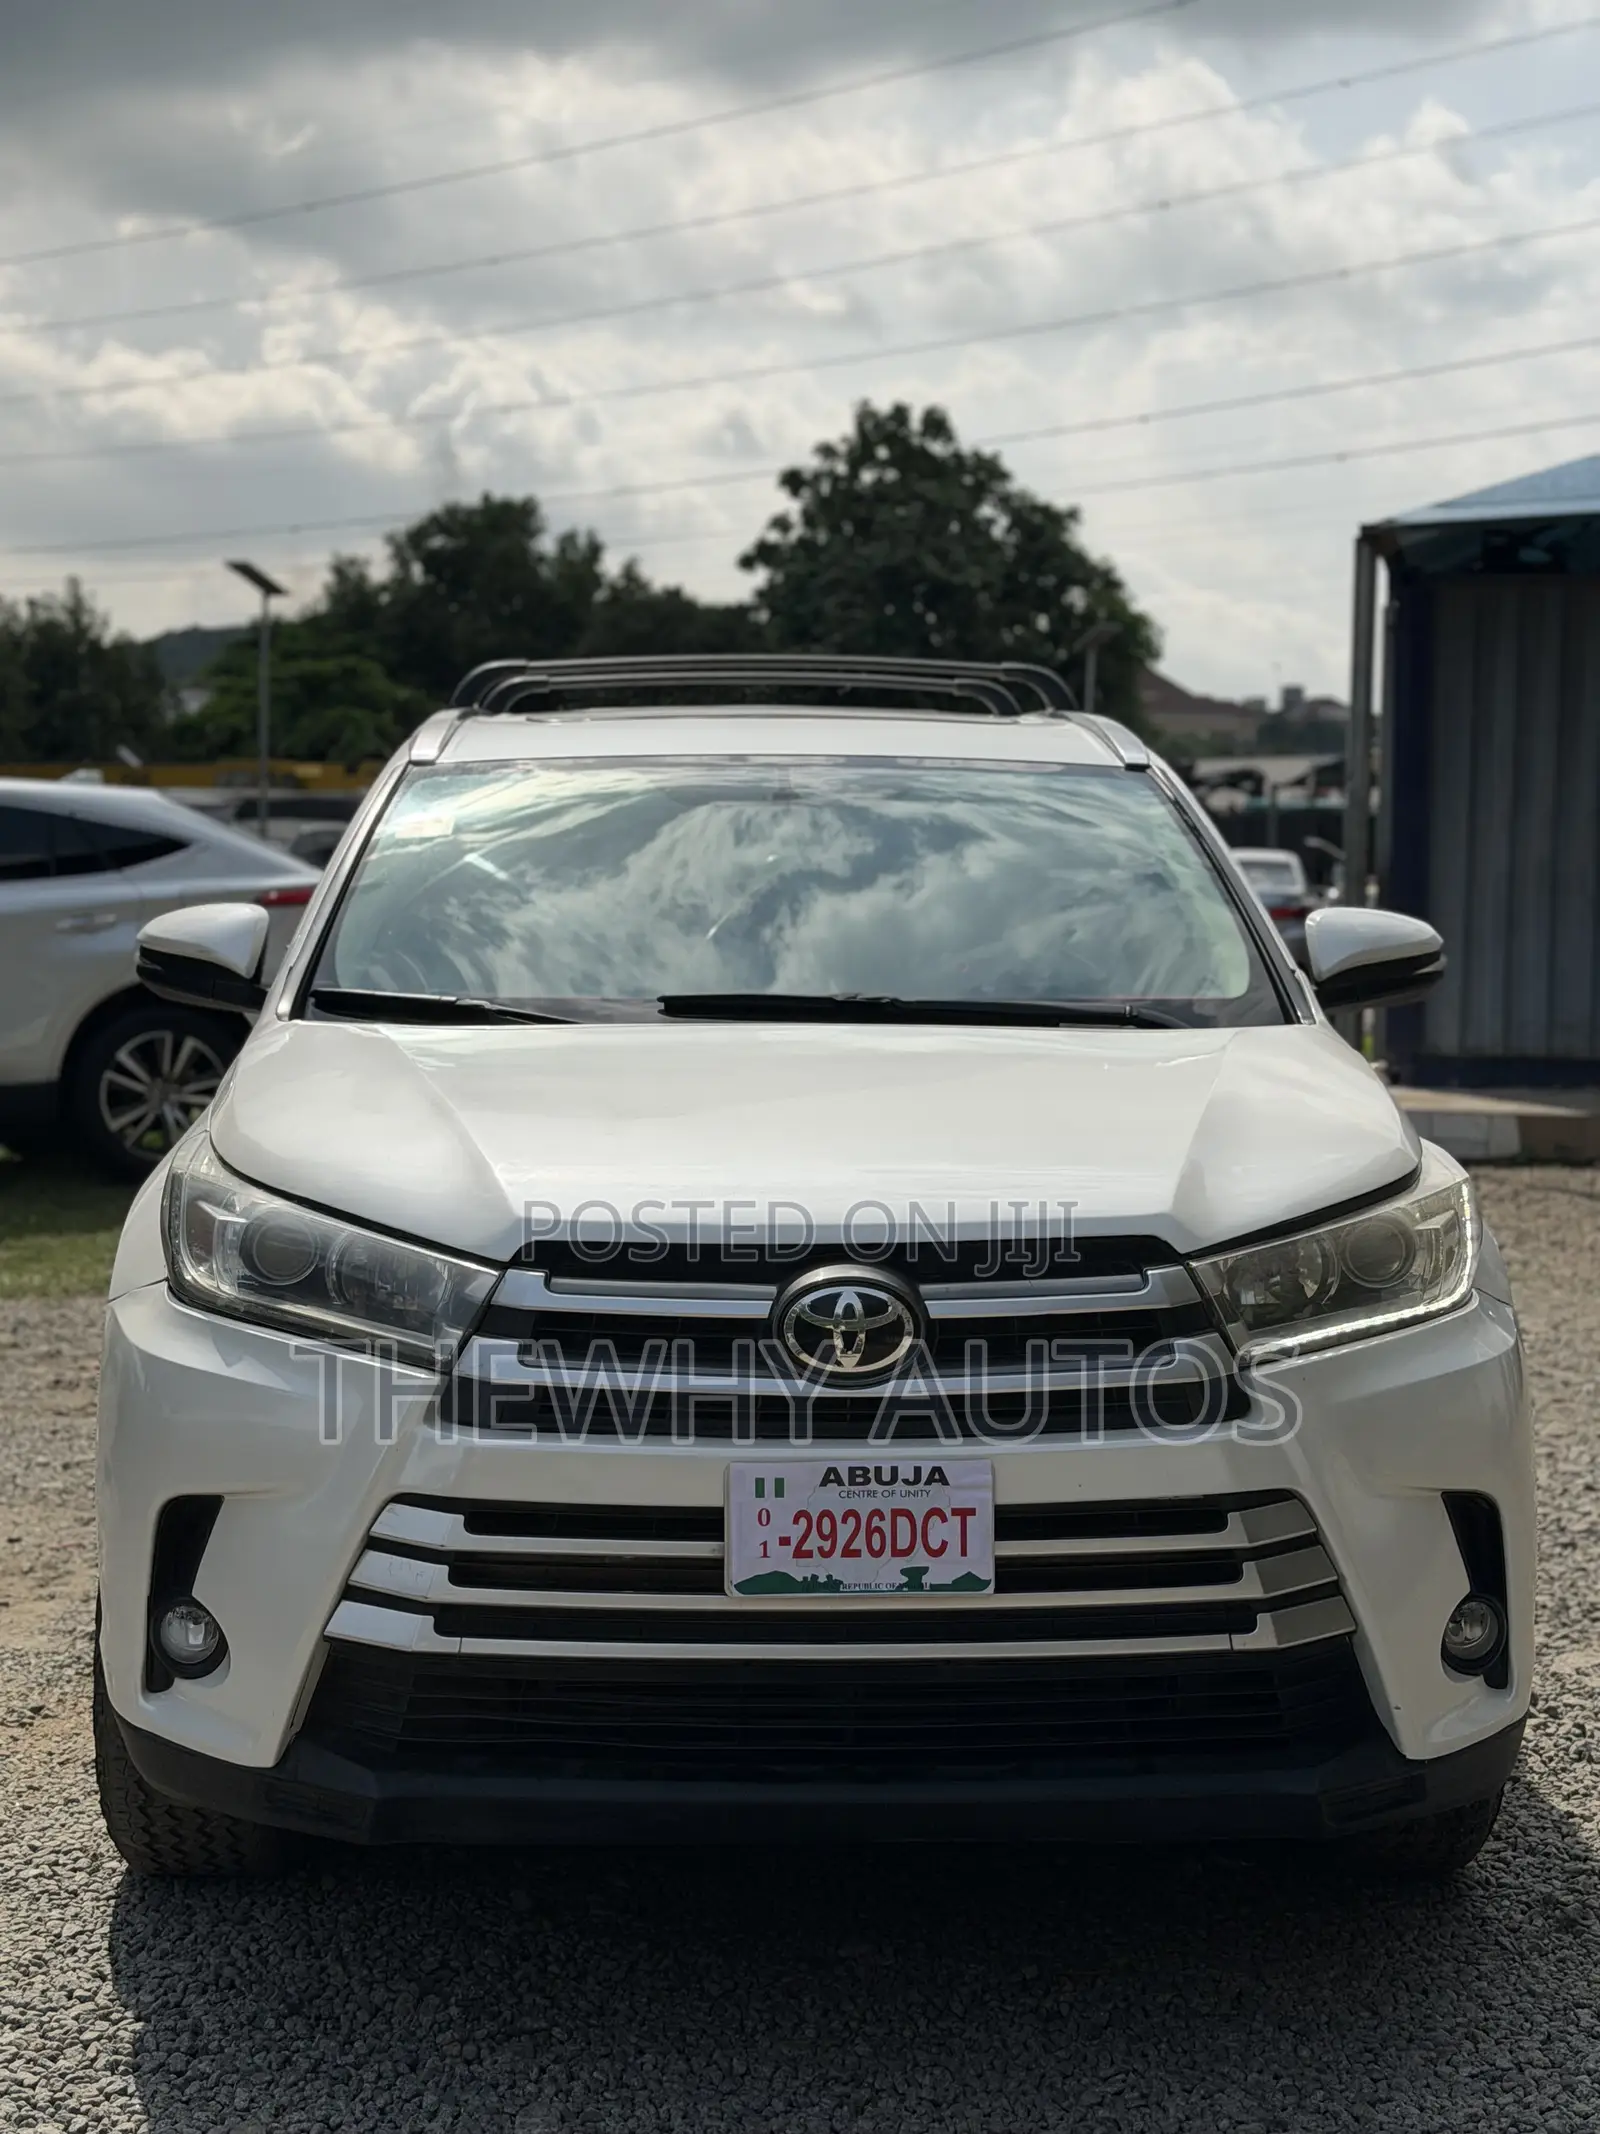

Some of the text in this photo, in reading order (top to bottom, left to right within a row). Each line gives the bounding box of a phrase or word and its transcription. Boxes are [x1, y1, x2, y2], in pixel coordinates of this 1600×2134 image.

[818, 1465, 951, 1488] ABUJA
[838, 1489, 931, 1499] CENTRE OF UNITY
[778, 1506, 977, 1560] -2926DCT
[842, 1582, 884, 1590] REPUBLIC
